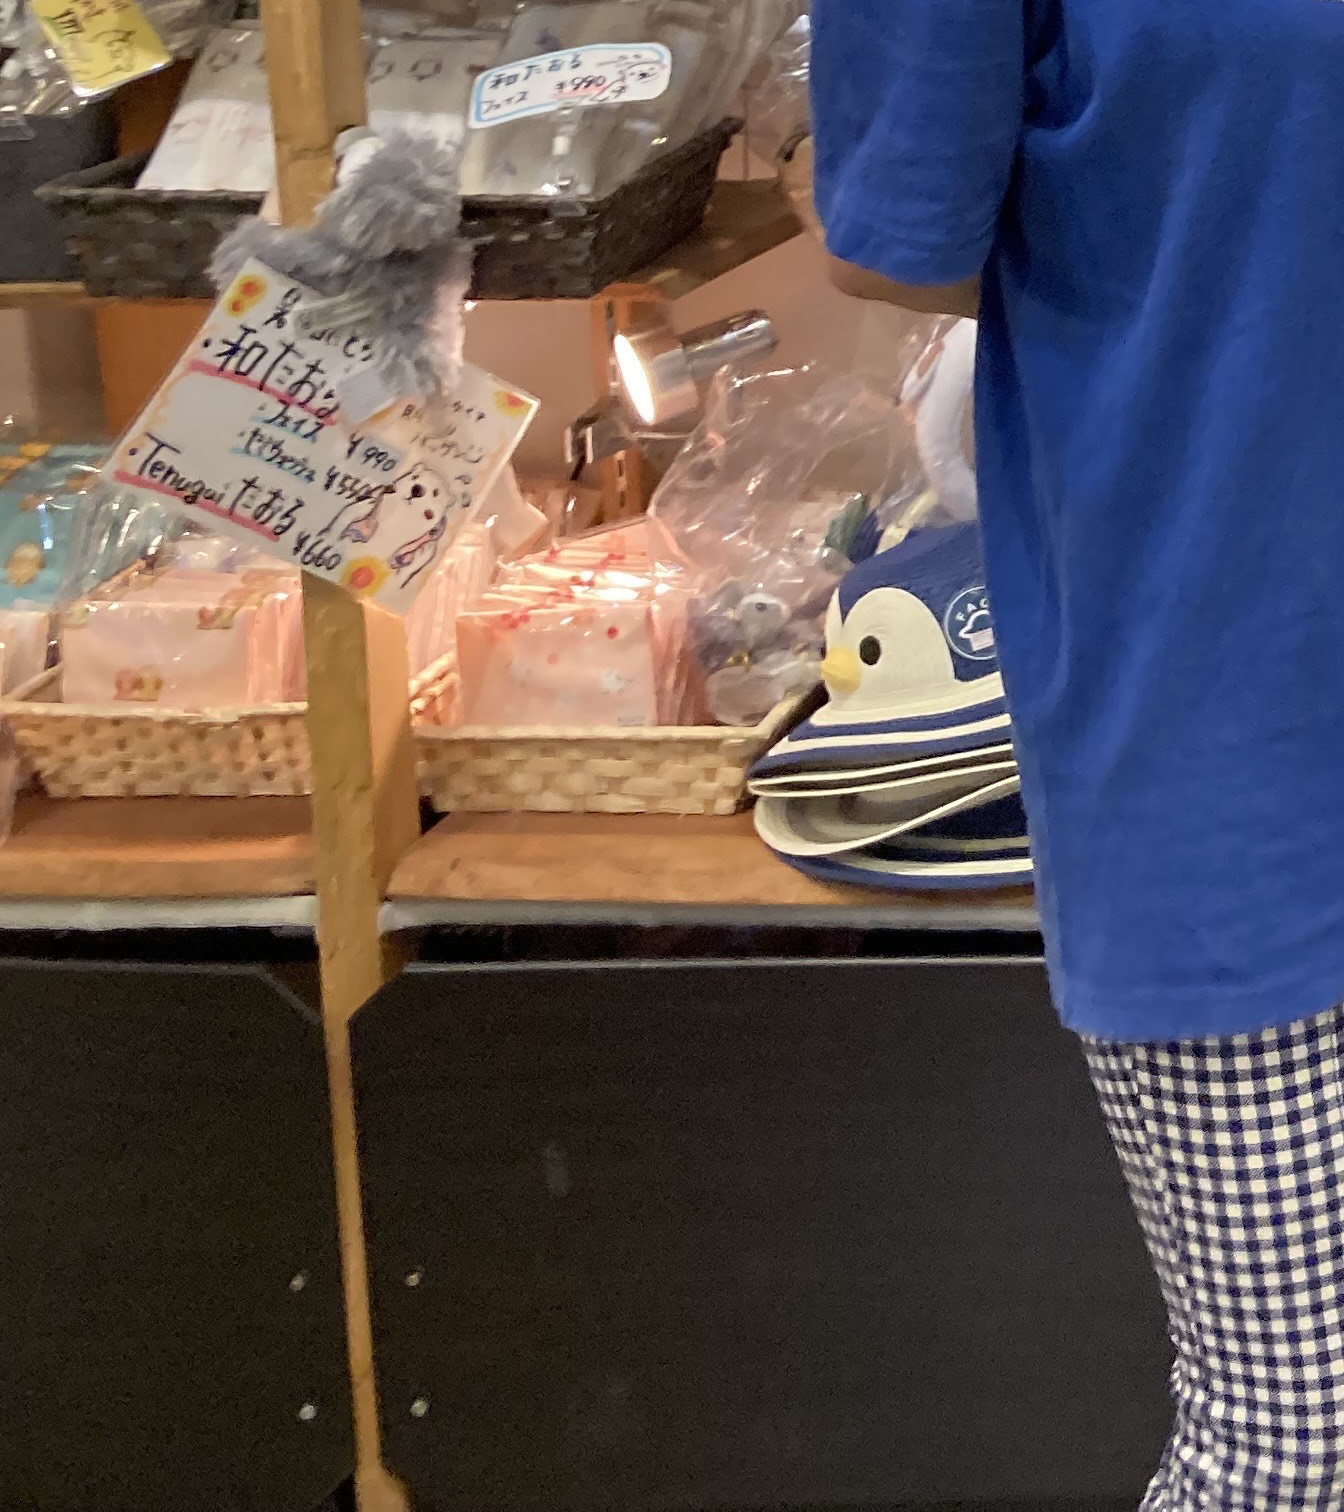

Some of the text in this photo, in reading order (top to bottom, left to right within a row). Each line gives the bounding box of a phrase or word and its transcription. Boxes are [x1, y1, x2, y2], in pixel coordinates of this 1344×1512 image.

[348, 432, 398, 472] ¥990
[230, 473, 305, 537] たおる
[293, 531, 342, 571] ¥660
